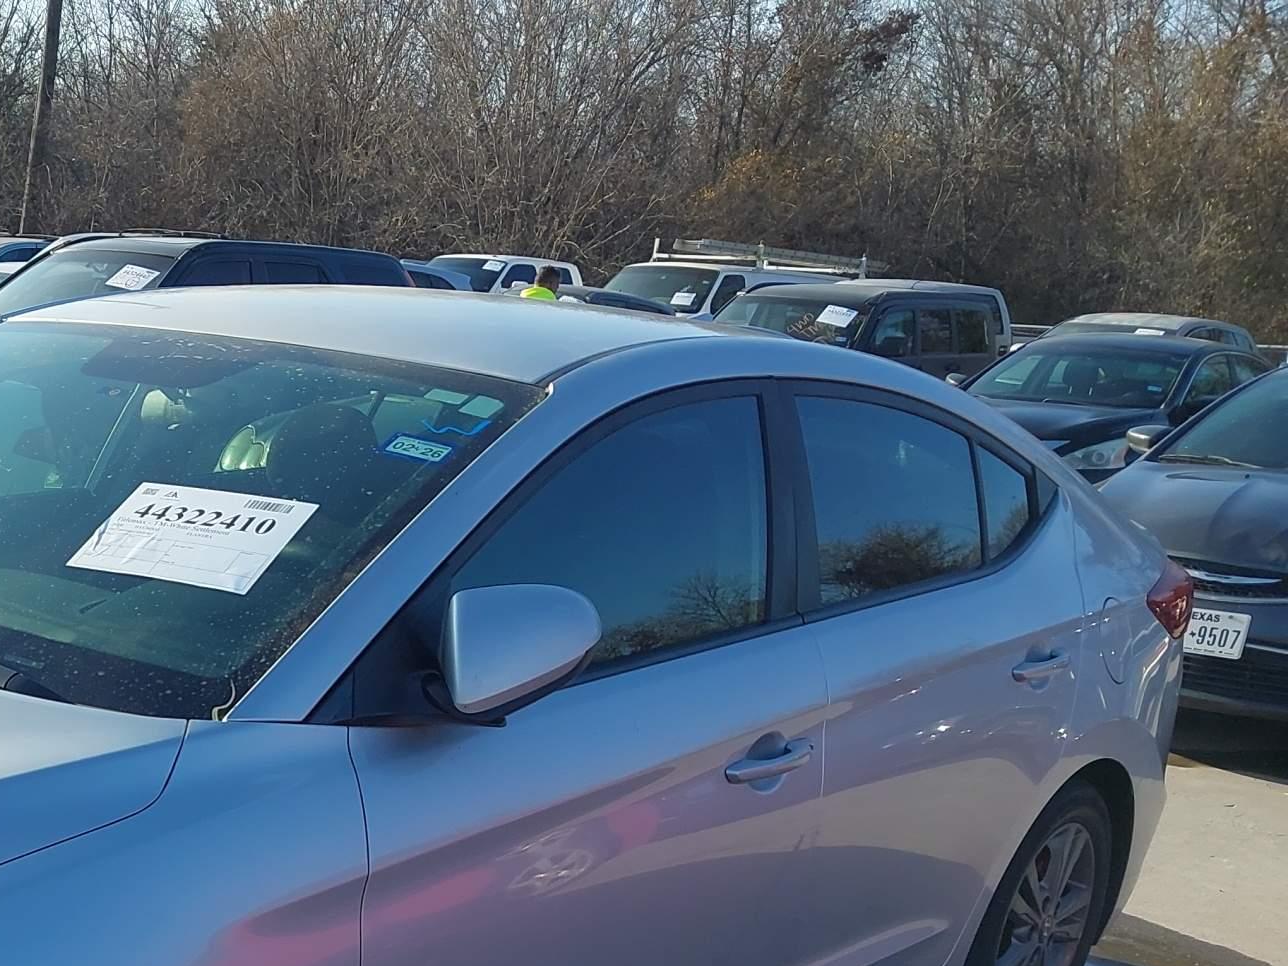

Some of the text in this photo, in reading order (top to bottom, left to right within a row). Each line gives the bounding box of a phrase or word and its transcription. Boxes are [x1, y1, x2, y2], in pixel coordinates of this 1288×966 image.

[392, 441, 413, 453] 02
[419, 447, 444, 459] 26
[133, 503, 277, 535] 44322410
[1191, 611, 1221, 623] EXAS
